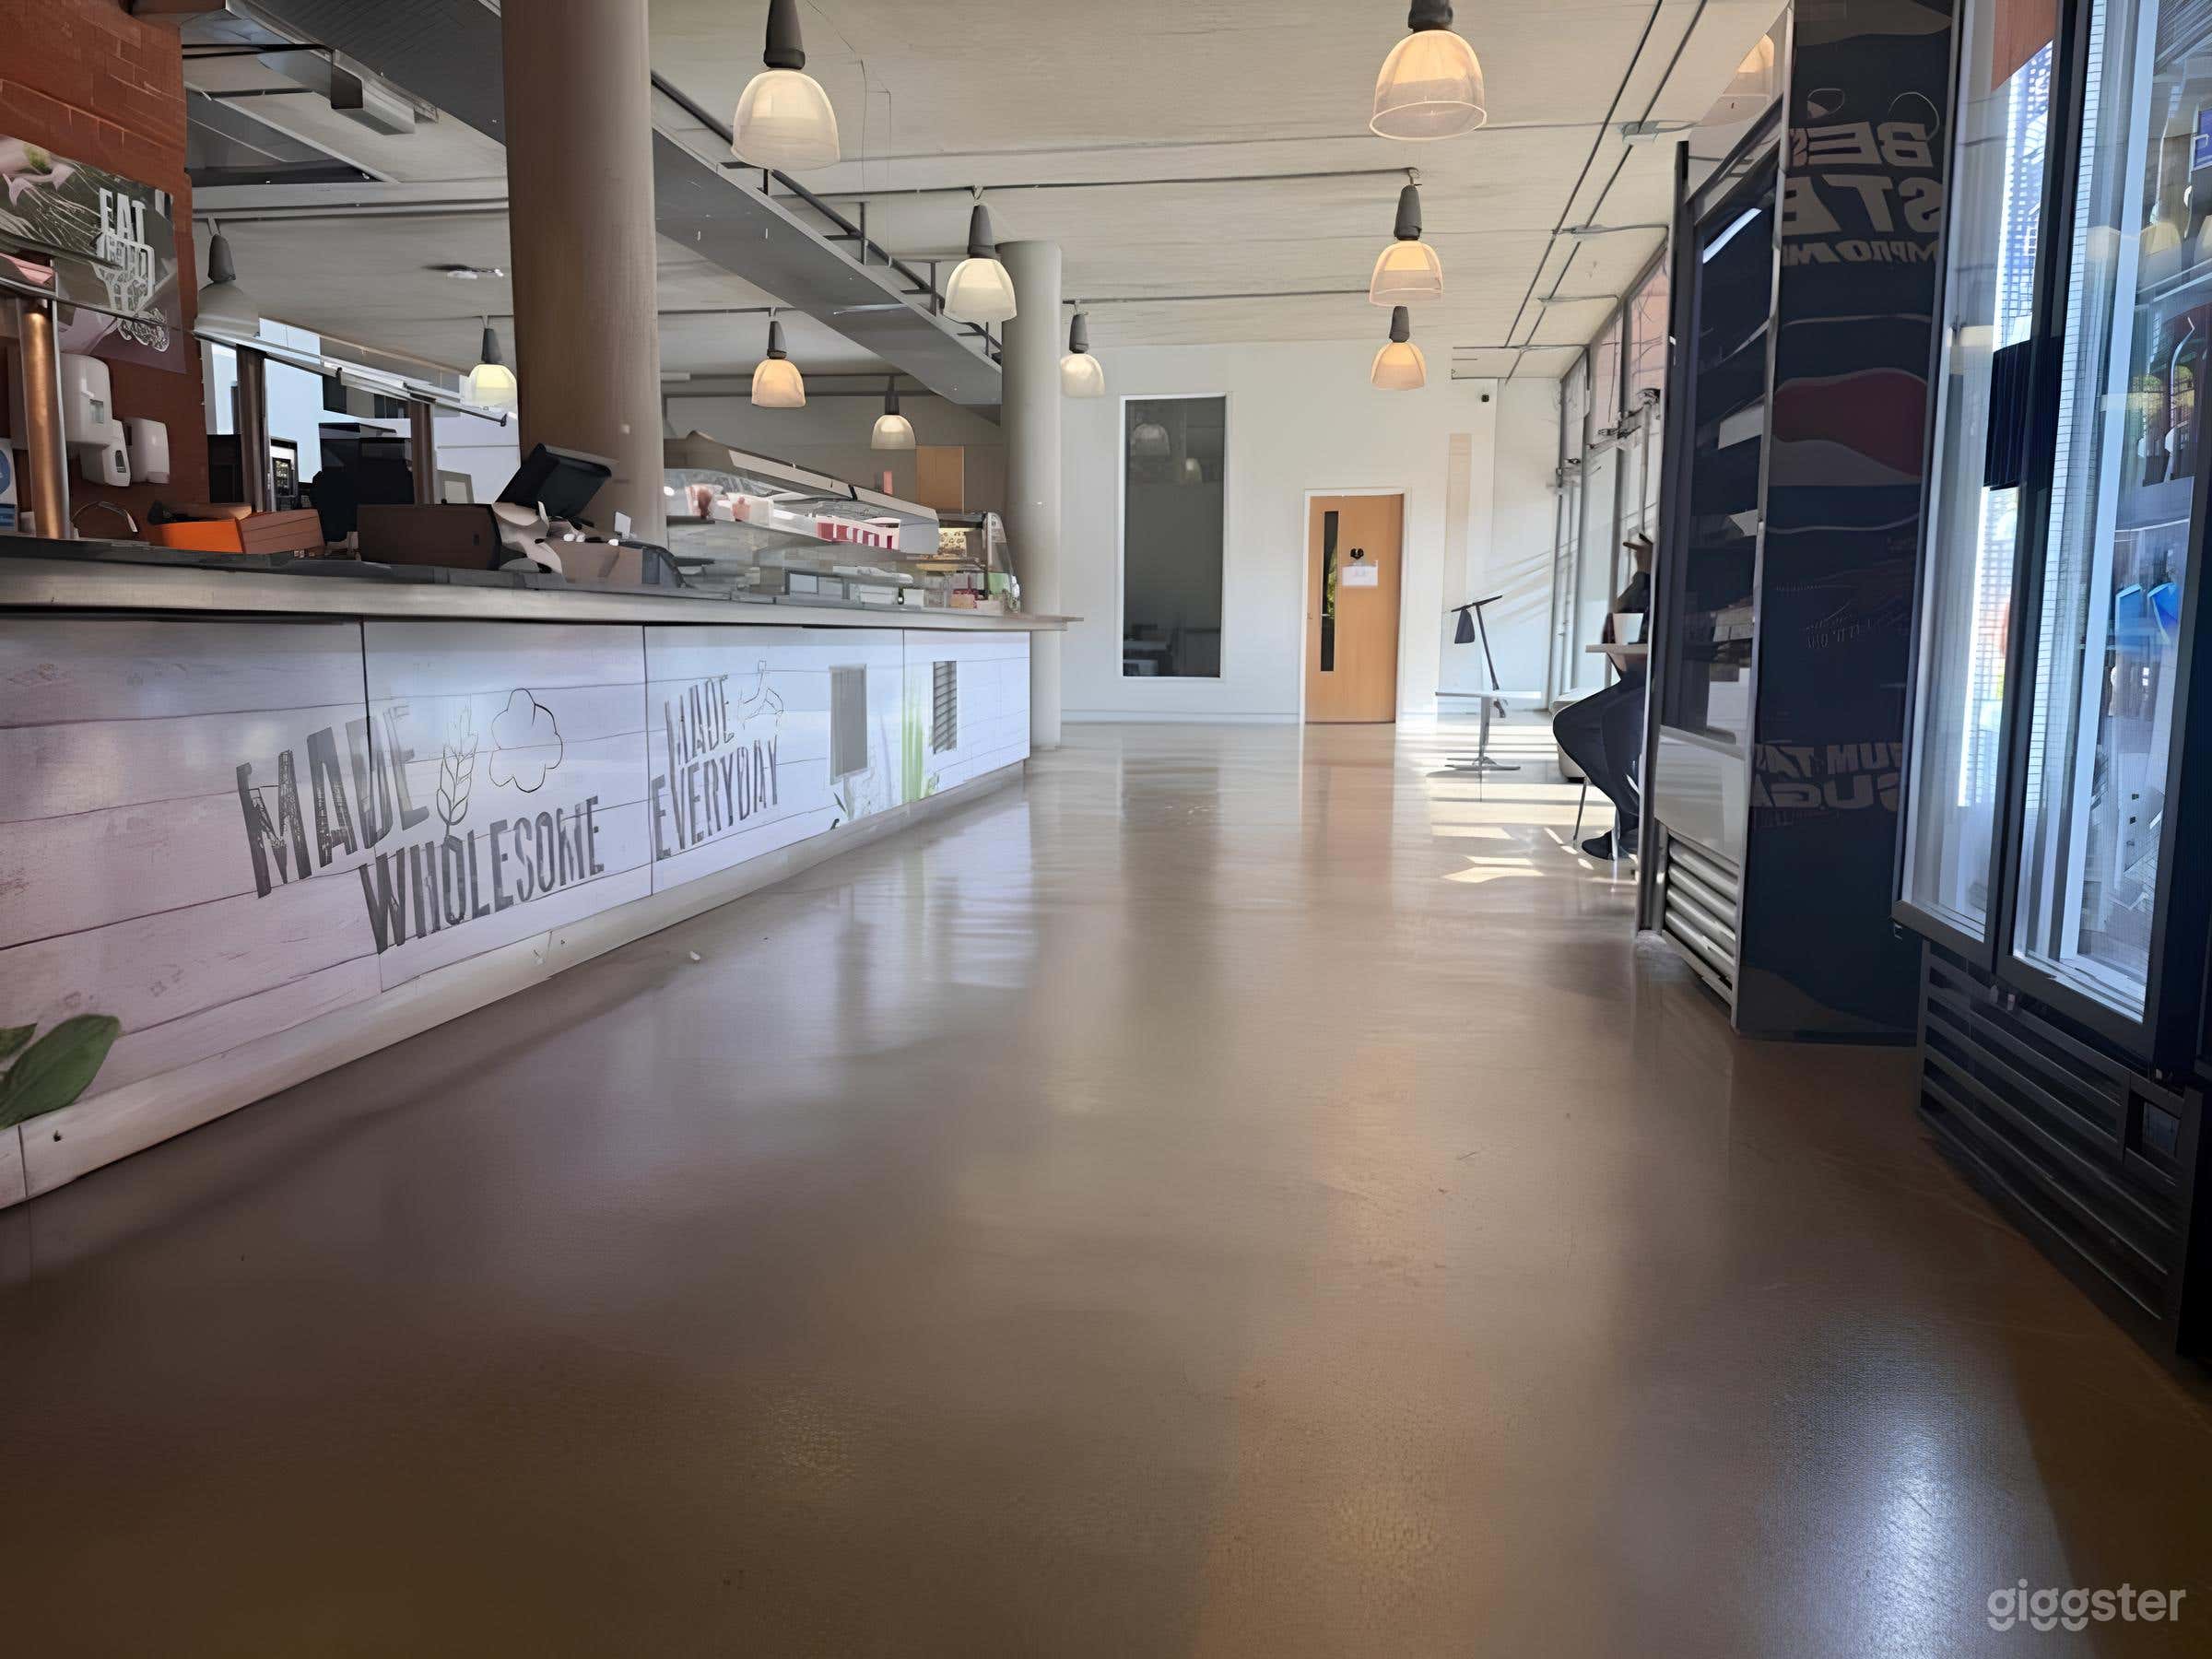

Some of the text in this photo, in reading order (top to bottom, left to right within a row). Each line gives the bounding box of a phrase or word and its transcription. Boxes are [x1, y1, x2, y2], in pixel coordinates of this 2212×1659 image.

[99, 187, 147, 245] EAT
[665, 674, 735, 767] MADE
[236, 704, 429, 899] MADE
[651, 735, 778, 861] EVERYDAY
[359, 795, 604, 955] WHOLESOME
